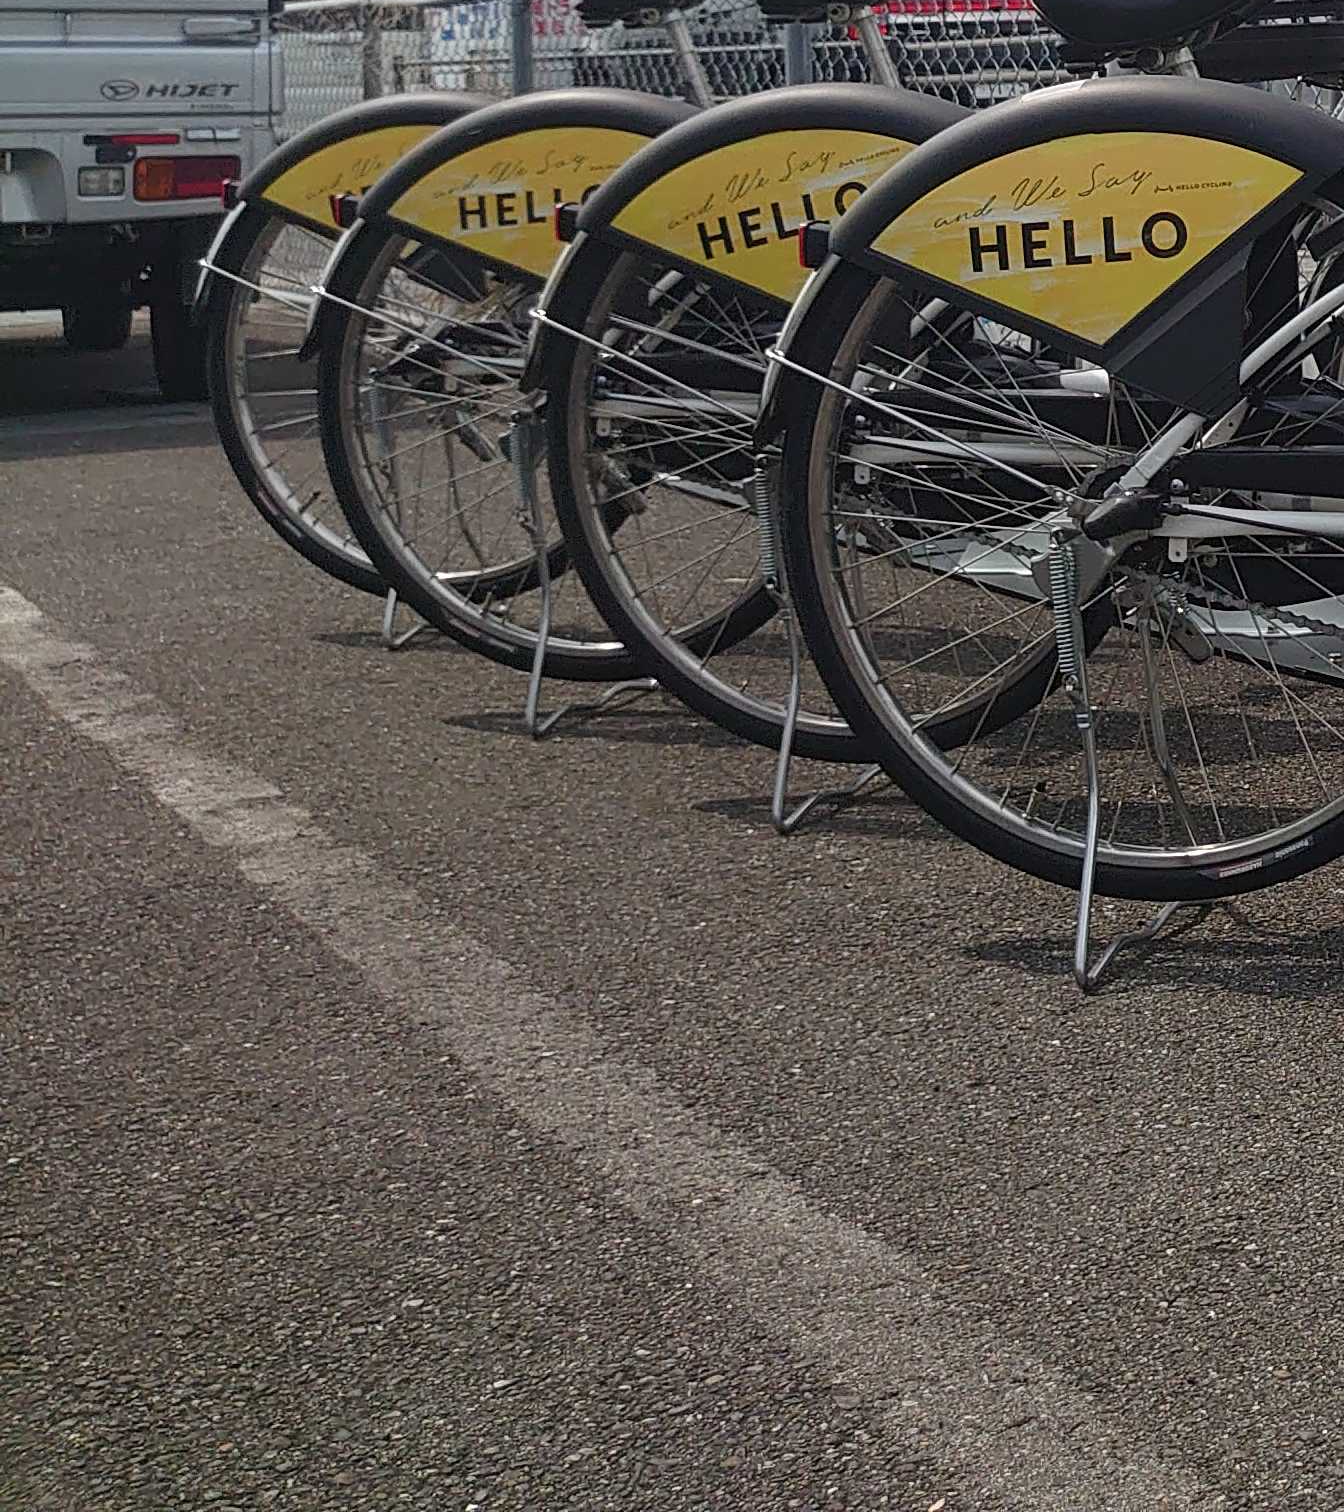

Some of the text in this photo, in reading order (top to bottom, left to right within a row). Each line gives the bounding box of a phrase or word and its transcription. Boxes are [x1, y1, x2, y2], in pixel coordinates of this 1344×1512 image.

[145, 84, 240, 97] HIJET
[725, 168, 769, 203] We
[778, 151, 836, 182] Say
[933, 163, 1153, 230] and We Say
[968, 211, 1188, 273] HELLO
